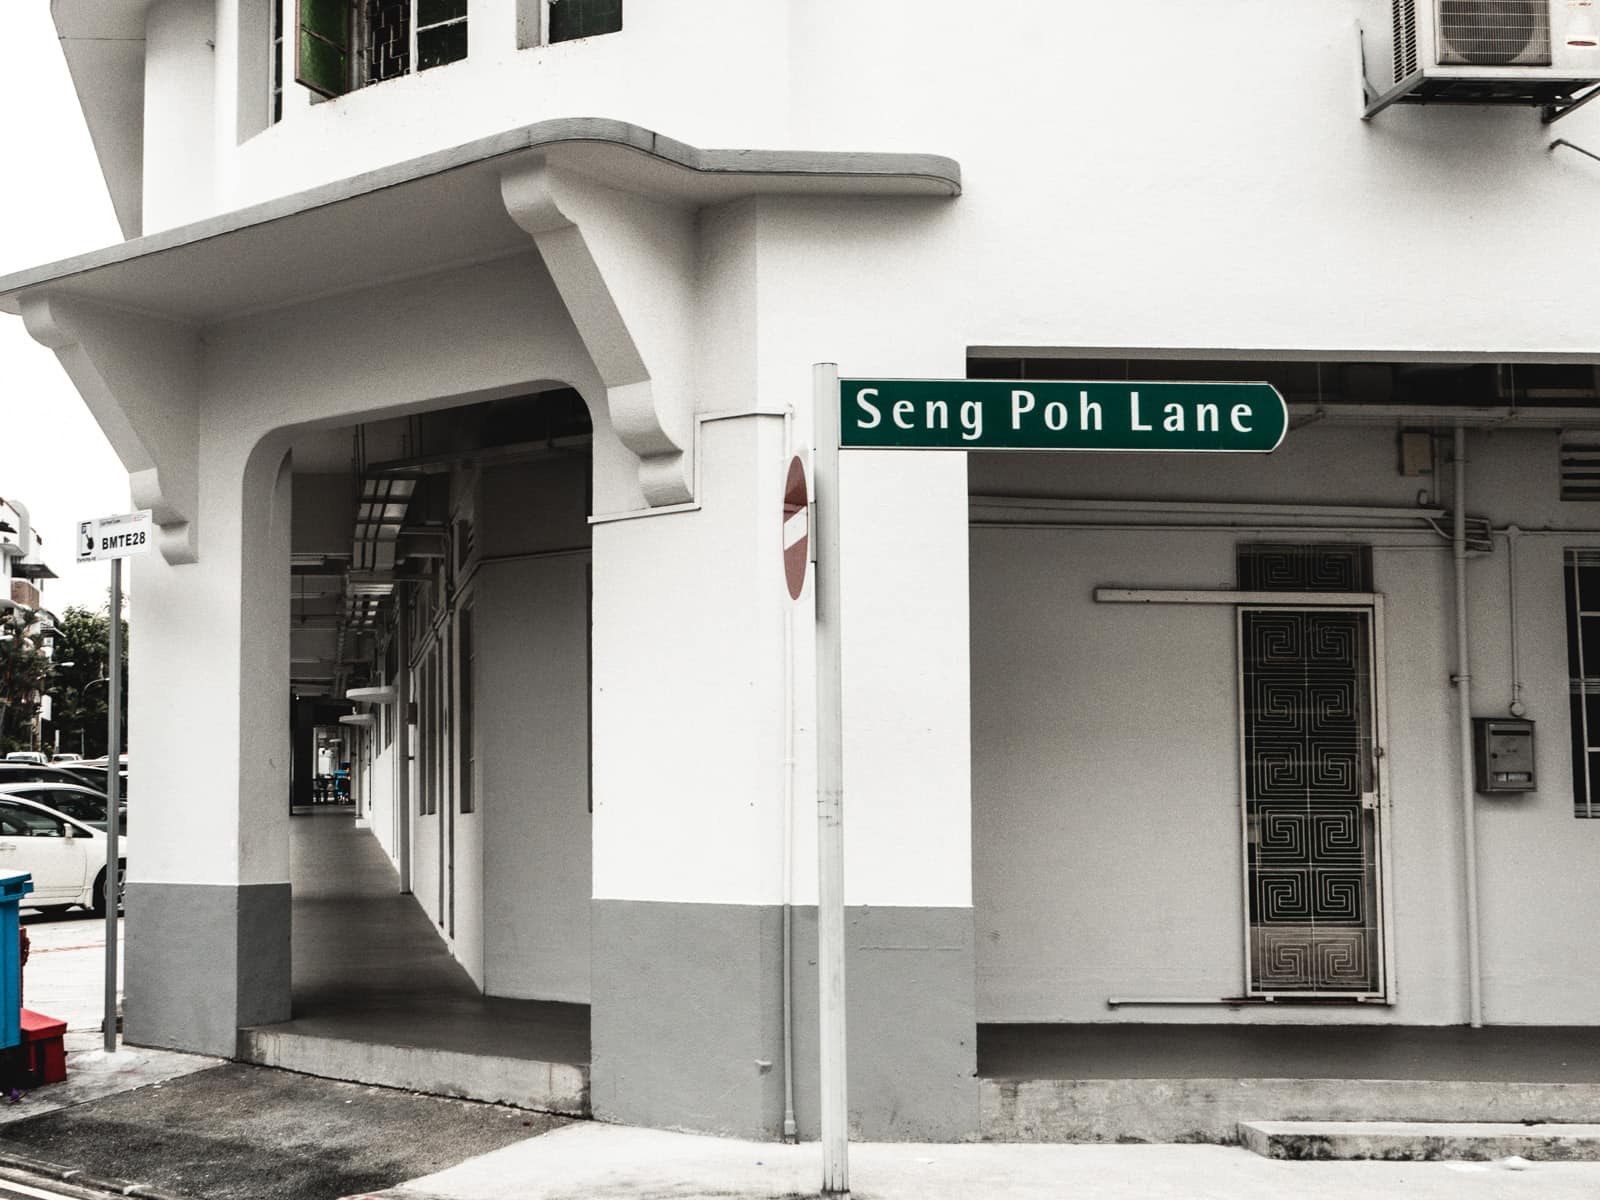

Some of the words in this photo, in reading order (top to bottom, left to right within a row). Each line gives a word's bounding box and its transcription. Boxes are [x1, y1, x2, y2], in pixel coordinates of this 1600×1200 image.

[856, 388, 983, 441] Seng
[1011, 390, 1102, 431] Poh
[1130, 391, 1253, 433] Lane
[102, 531, 146, 551] BMTE28
